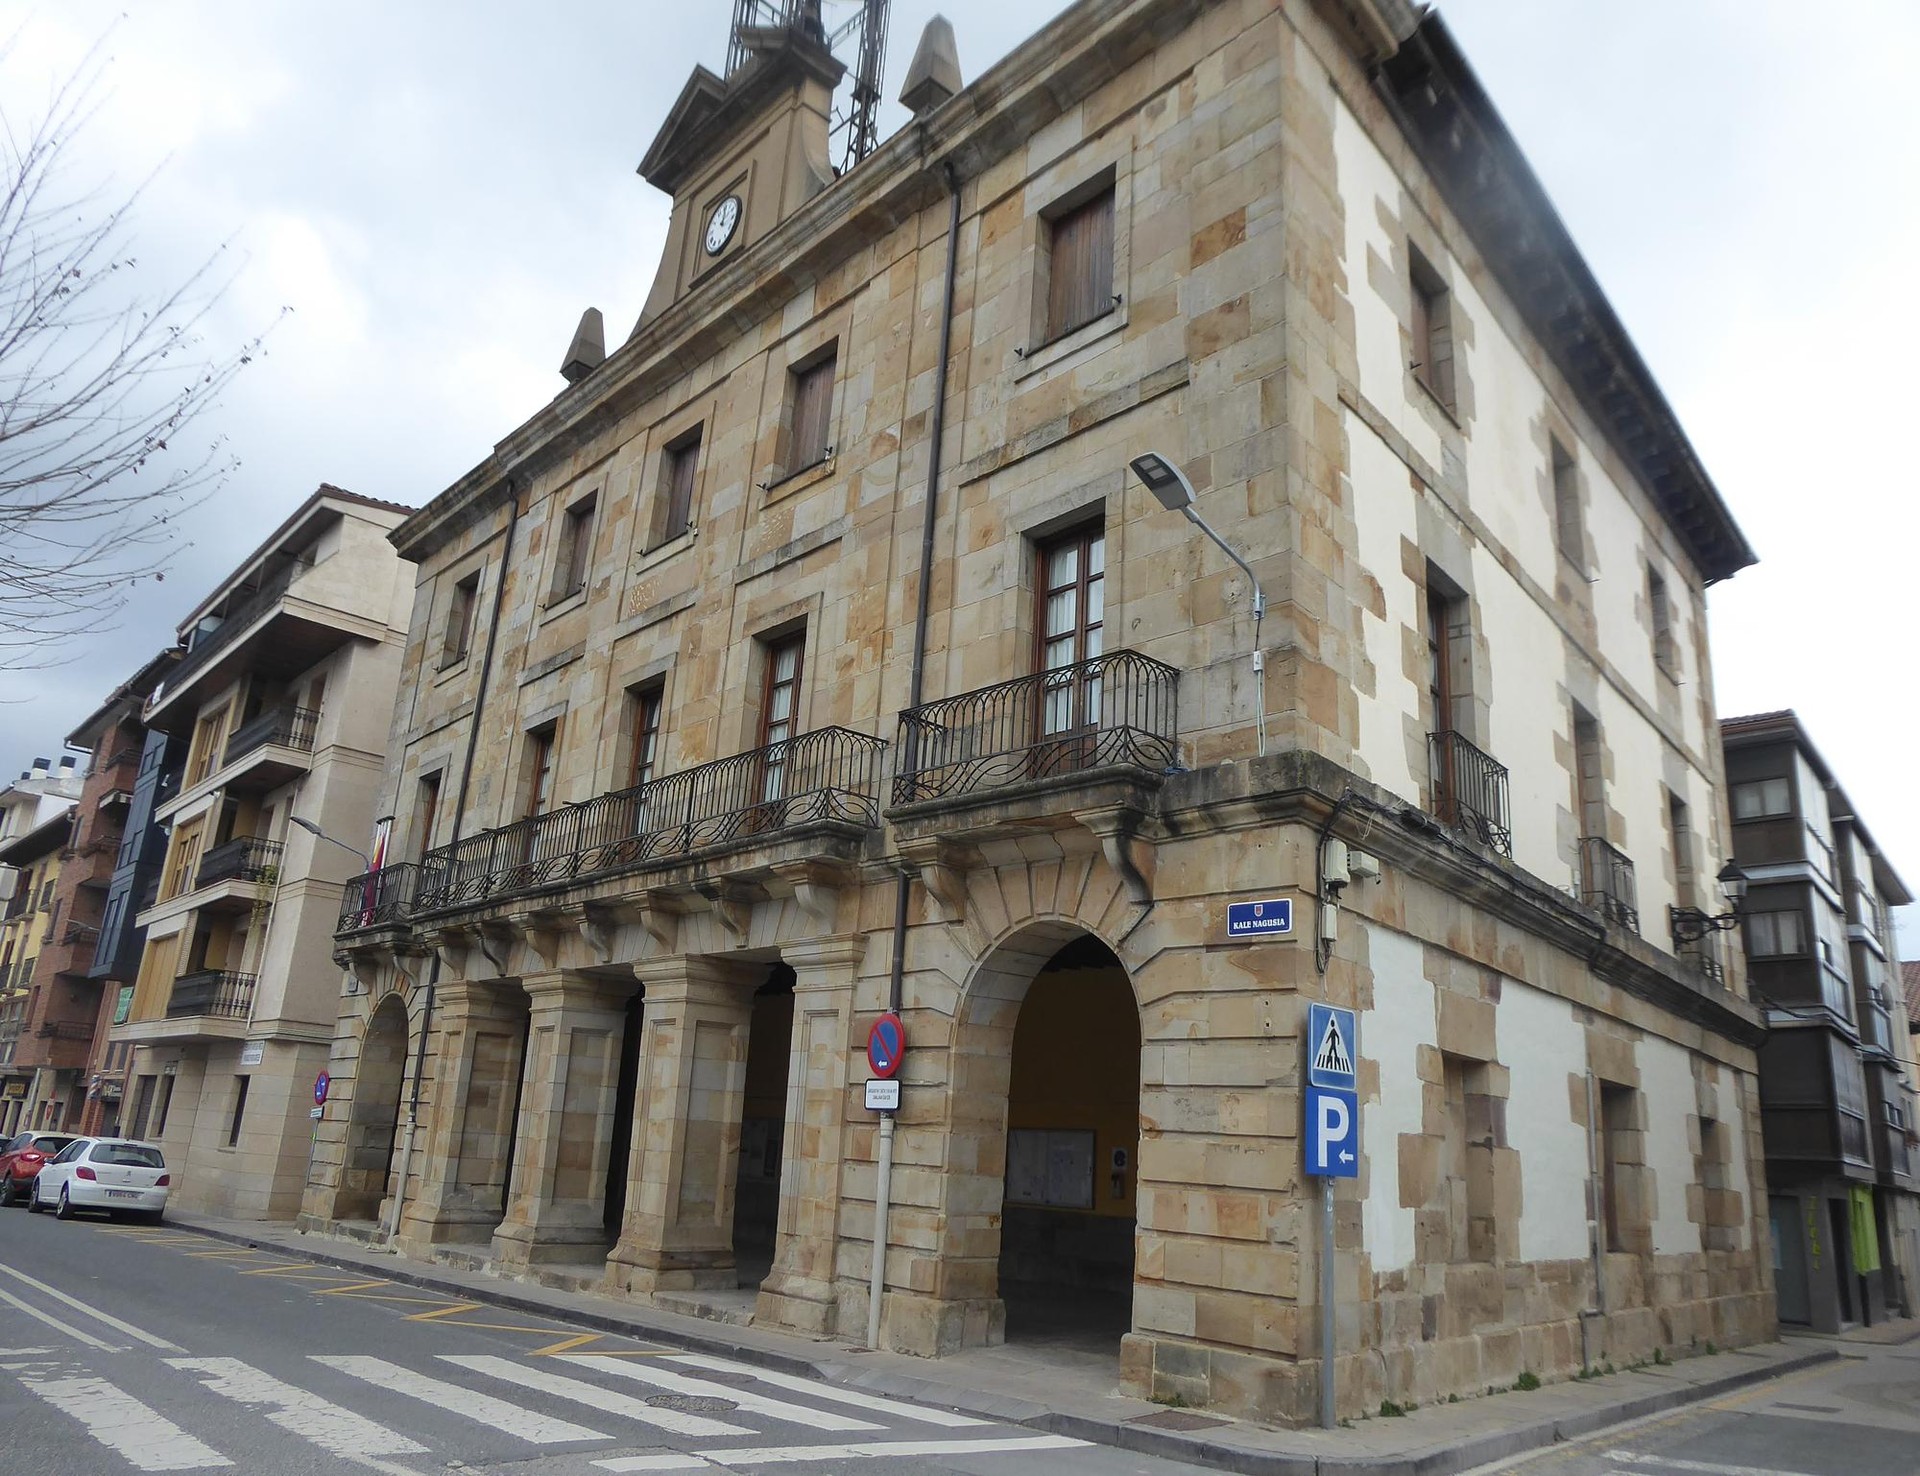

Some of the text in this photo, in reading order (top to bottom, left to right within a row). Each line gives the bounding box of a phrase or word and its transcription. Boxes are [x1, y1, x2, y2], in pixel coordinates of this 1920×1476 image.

[1233, 918, 1285, 930] KALE NAGUSIA
[1317, 1095, 1350, 1168] P
